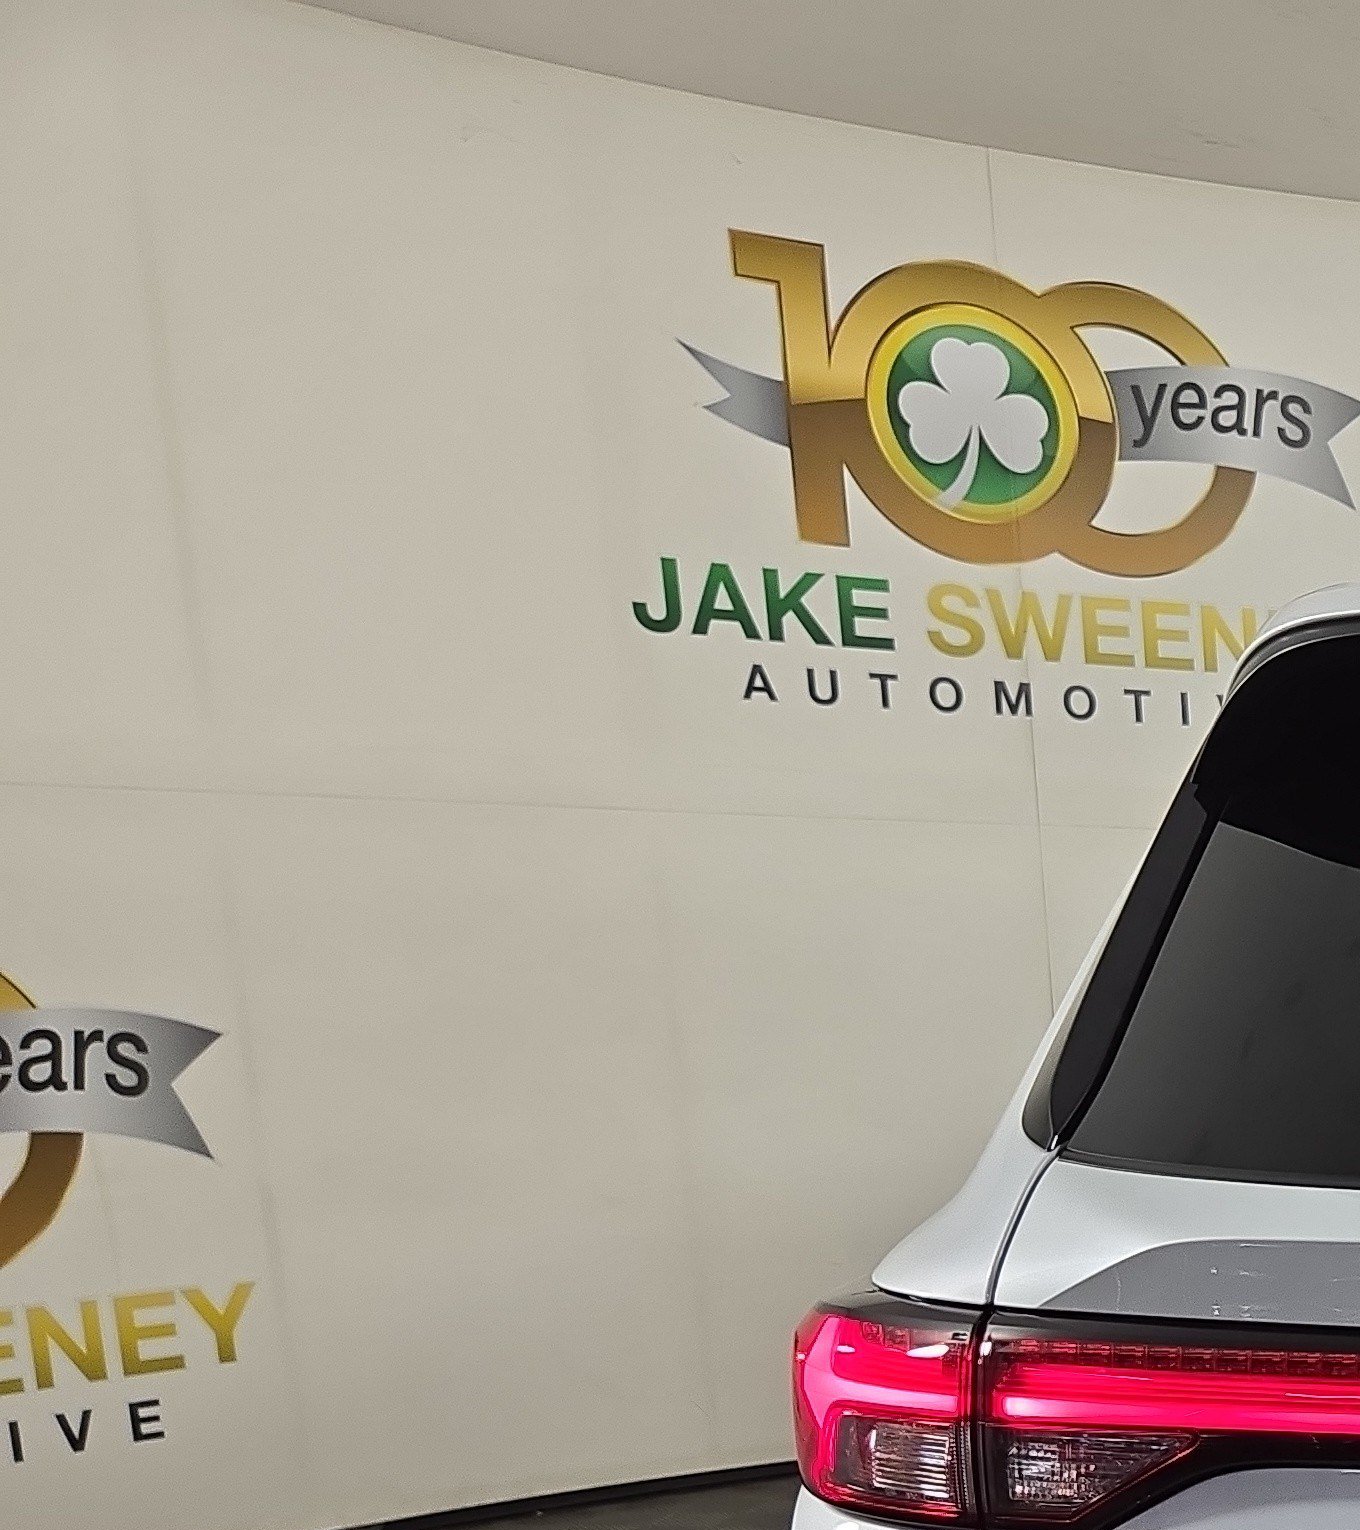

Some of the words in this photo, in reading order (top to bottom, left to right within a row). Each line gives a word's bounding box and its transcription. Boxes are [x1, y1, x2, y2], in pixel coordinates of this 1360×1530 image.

[1129, 380, 1313, 449] years
[631, 556, 896, 651] JAKE
[926, 583, 1257, 673] SWEEN
[743, 664, 1224, 726] AUTOMOTI
[0, 1028, 150, 1098] ars
